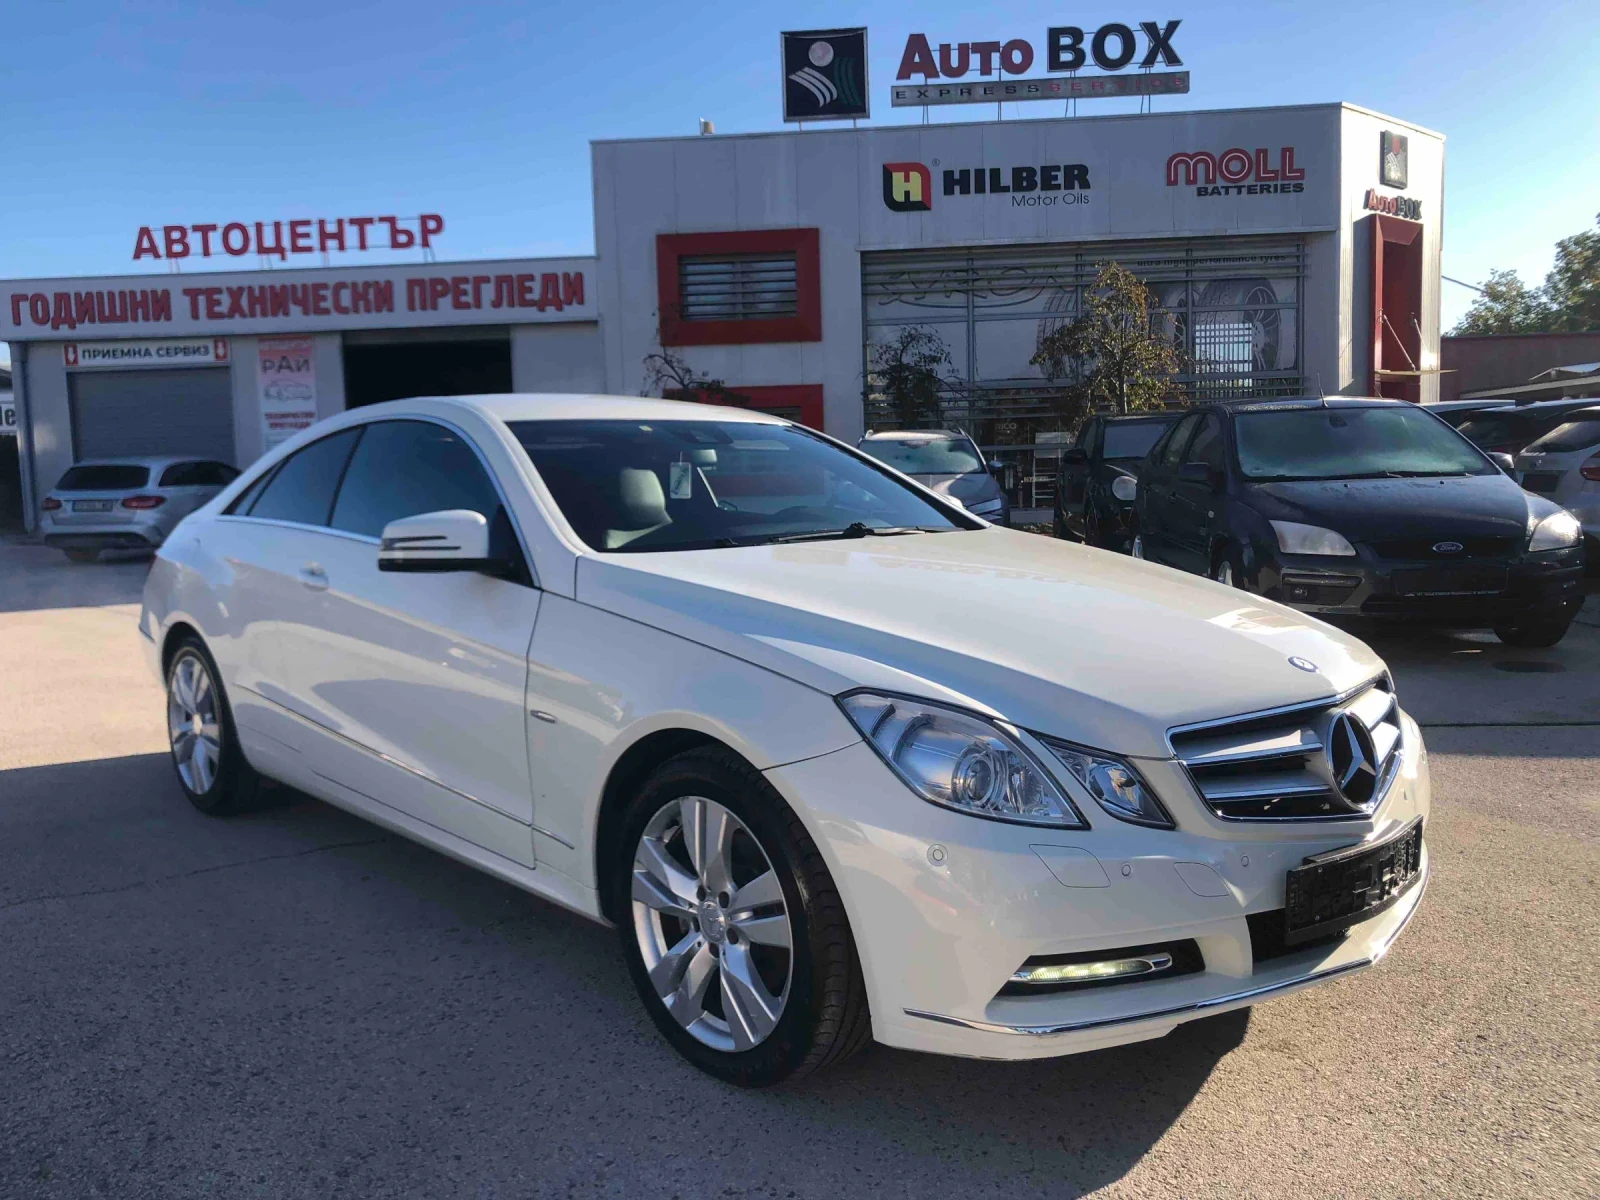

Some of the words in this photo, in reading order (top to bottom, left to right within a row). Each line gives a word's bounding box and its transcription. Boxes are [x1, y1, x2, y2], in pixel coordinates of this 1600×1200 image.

[1047, 19, 1184, 72] BOX
[895, 84, 1040, 100] EXPRESS
[942, 163, 1091, 196] HILBER
[1196, 182, 1305, 197] BATTERIES
[1011, 193, 1058, 207] Motor
[1062, 192, 1090, 206] Oils
[132, 214, 444, 260] АВТОЦЕНТЪР
[10, 288, 173, 331] ГОДИШНИ
[181, 279, 395, 321] ТЕХНИЧЕСКИ
[405, 271, 585, 313] ПРЕГЛЕДИ
[82, 347, 153, 360] ПРИЕМНА
[156, 345, 211, 358] СЕРВИЗ
